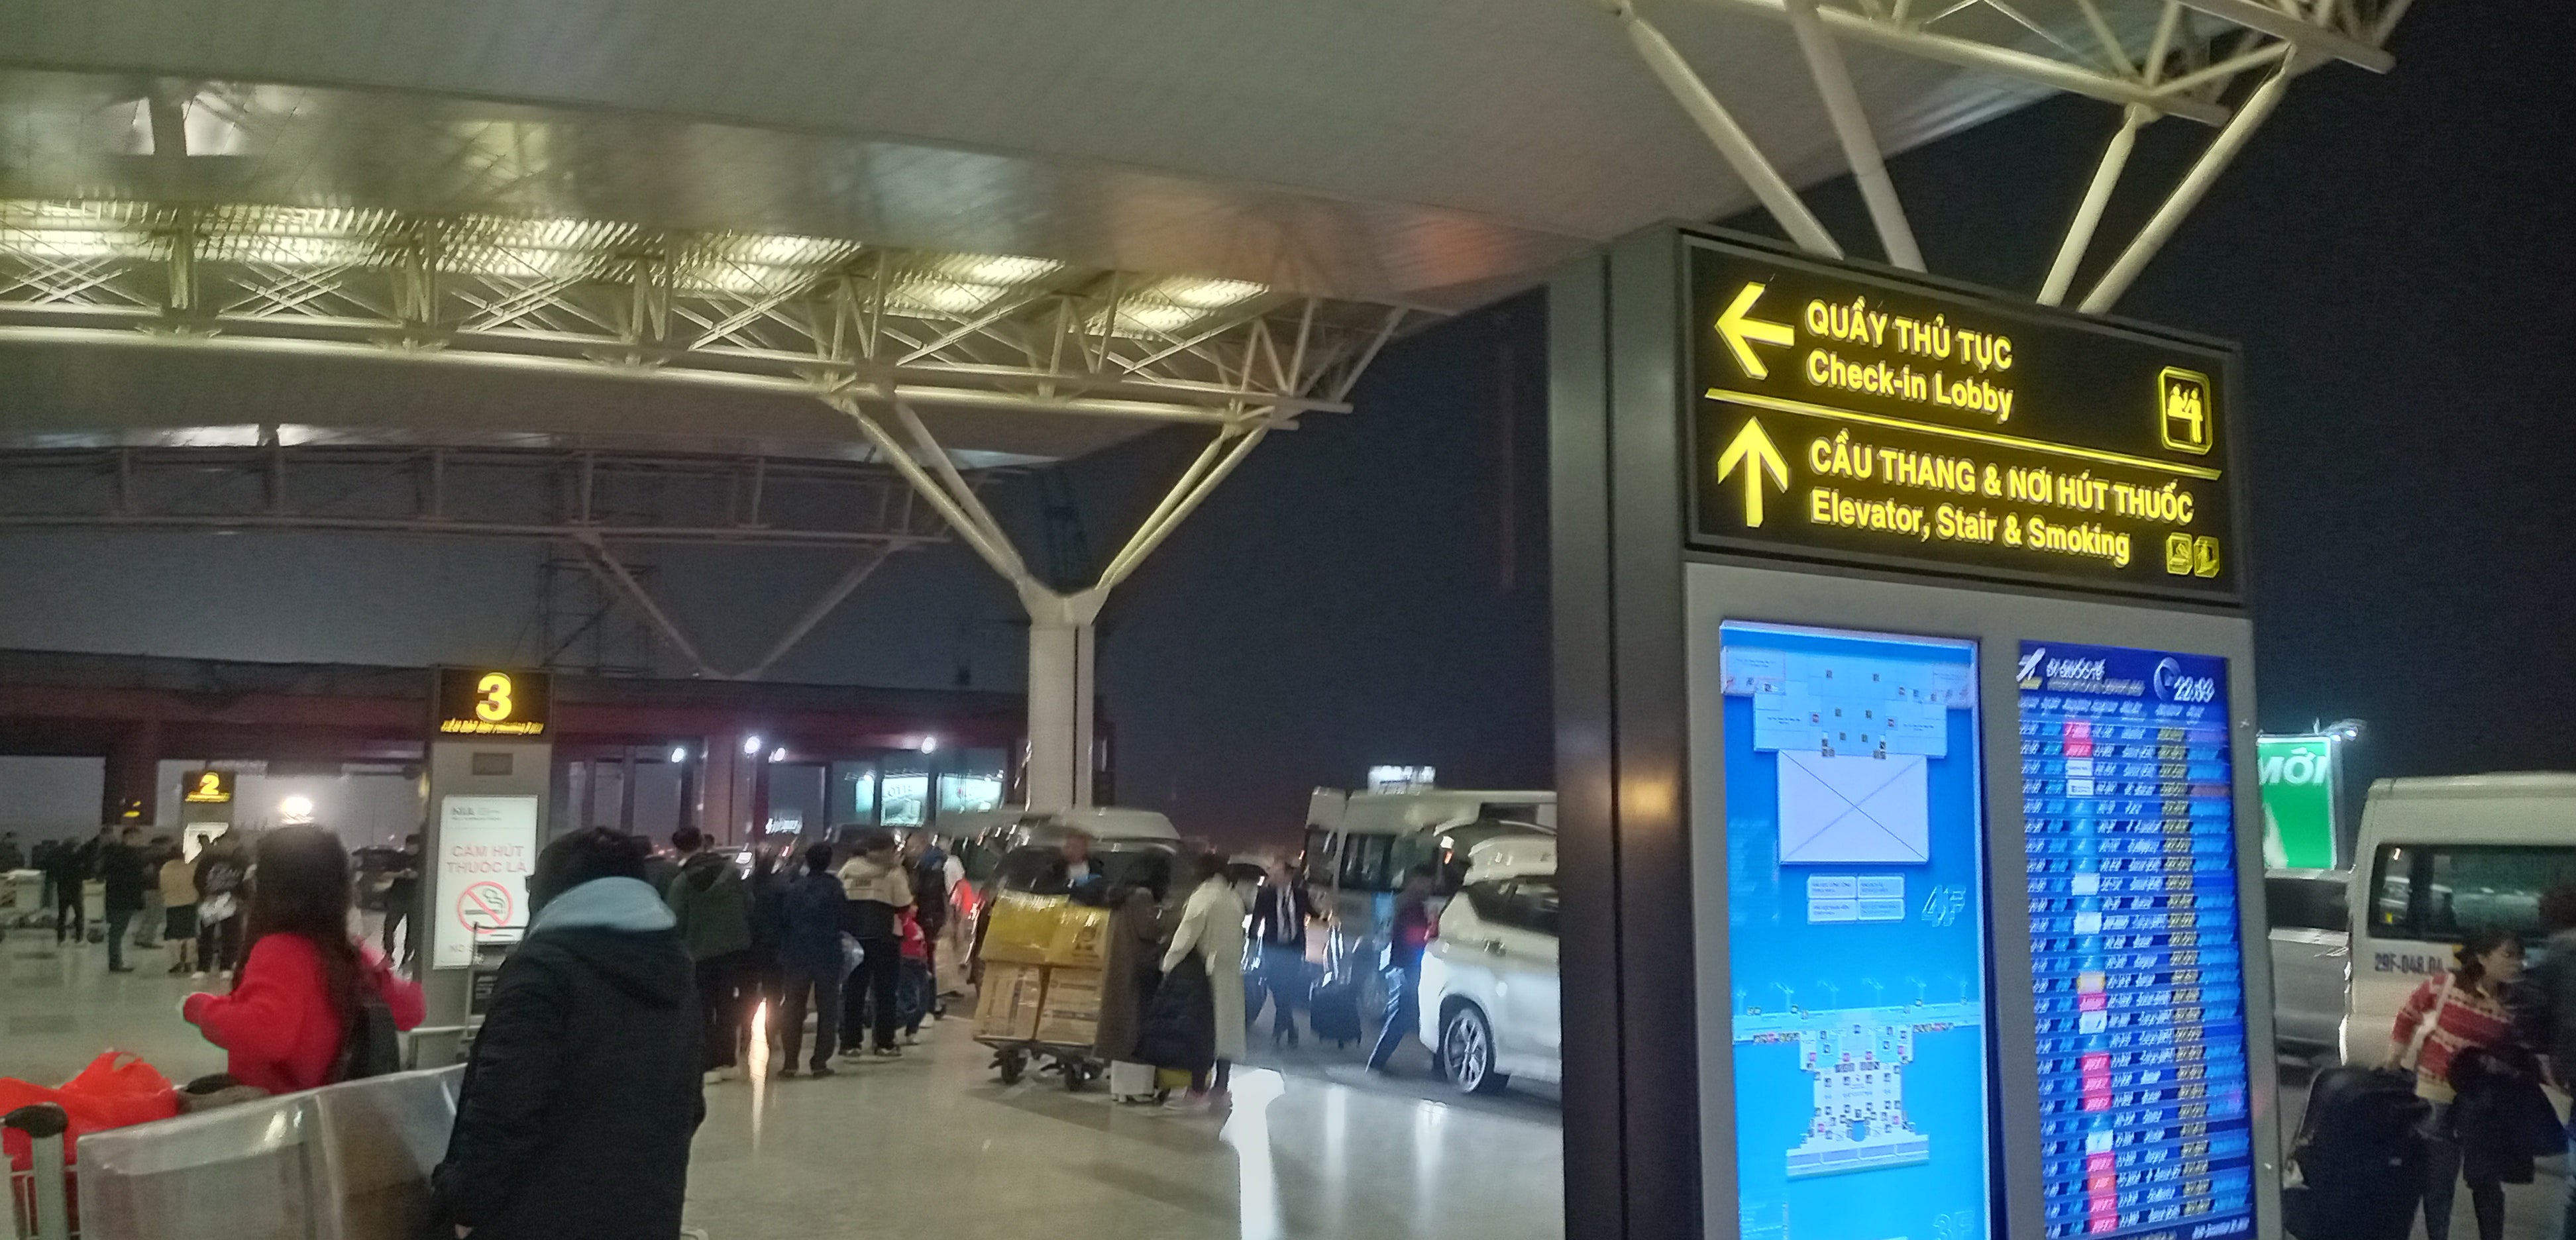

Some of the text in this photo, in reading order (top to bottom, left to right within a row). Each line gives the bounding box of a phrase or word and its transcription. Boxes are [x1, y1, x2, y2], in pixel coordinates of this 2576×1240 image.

[1806, 296, 2013, 372] QUẦY THỦ TỤC
[1807, 348, 2013, 424] Check-in Lobby
[1809, 428, 2194, 526] CẦU THANG & NƠI HÚT THUỐC
[1811, 486, 2131, 568] Elevator, Stair & Smoking
[476, 672, 513, 722] 3
[199, 772, 219, 796] 2
